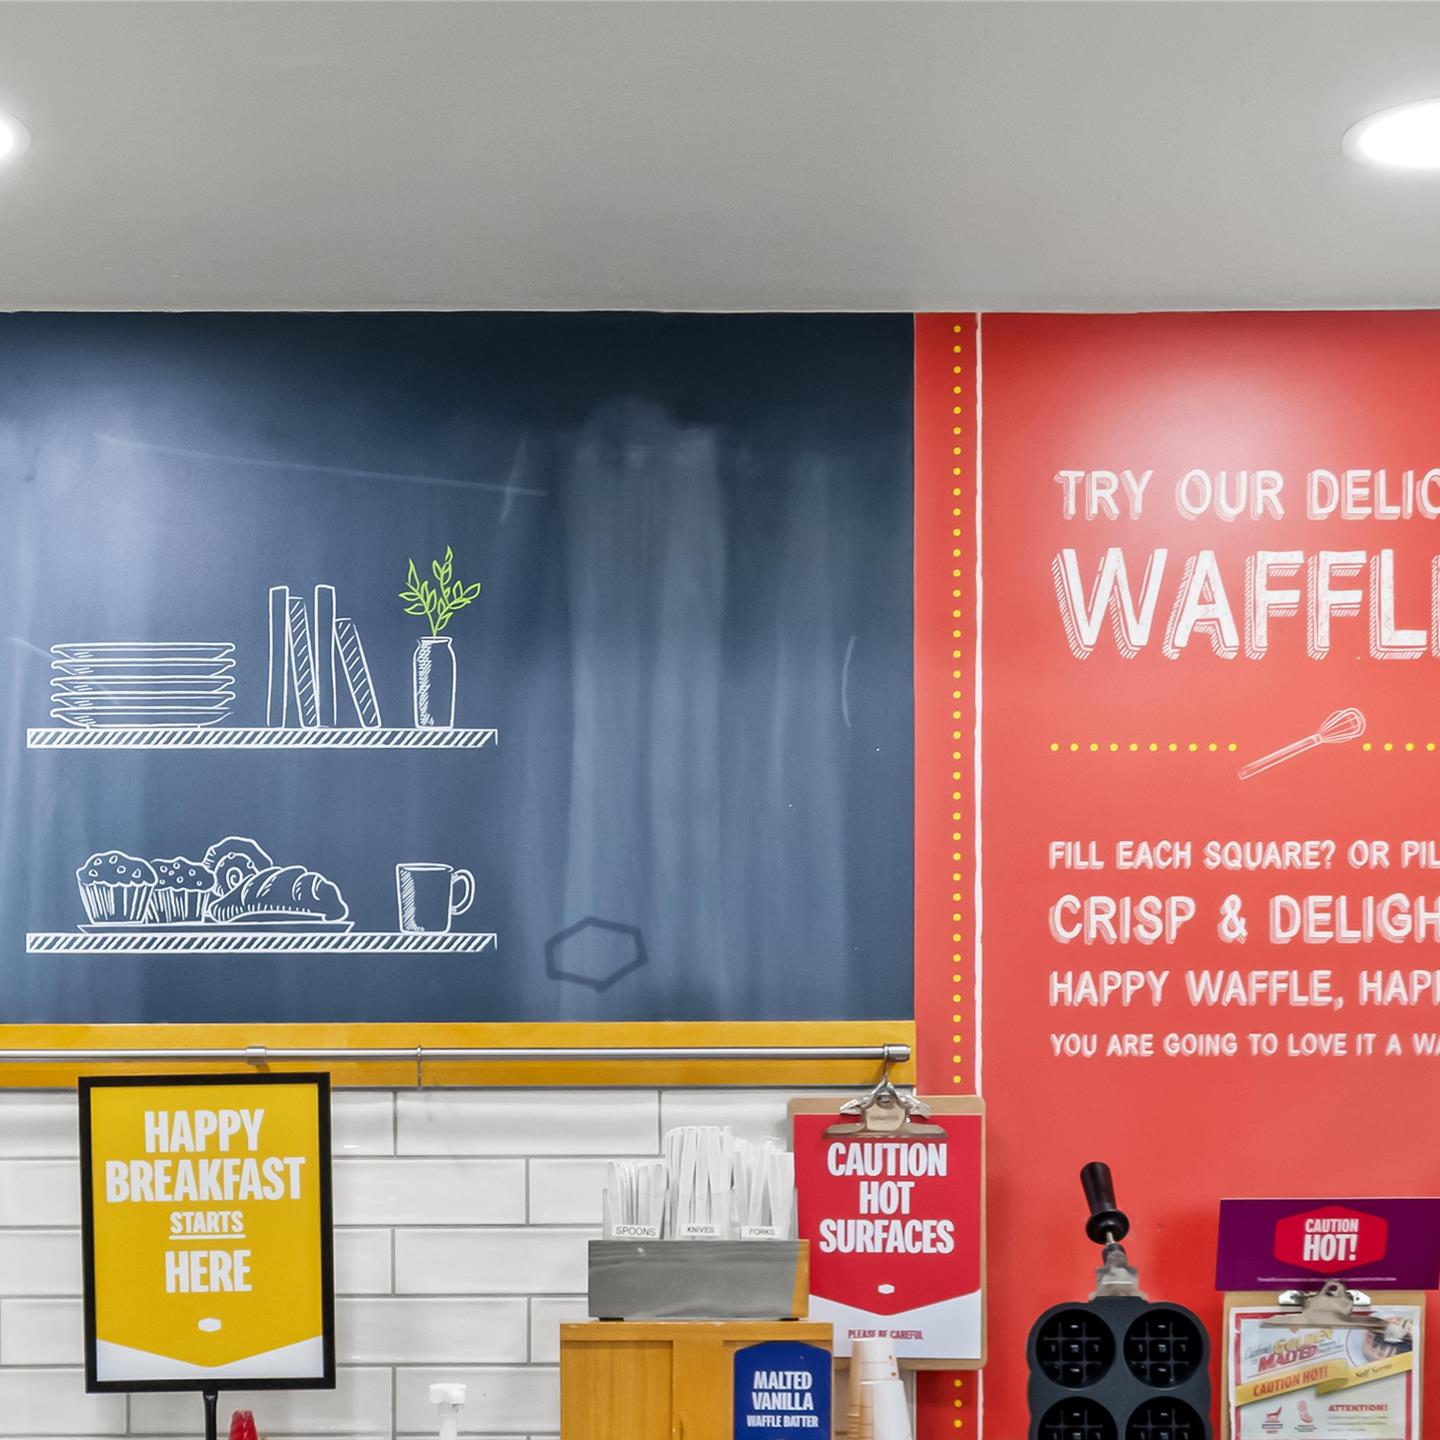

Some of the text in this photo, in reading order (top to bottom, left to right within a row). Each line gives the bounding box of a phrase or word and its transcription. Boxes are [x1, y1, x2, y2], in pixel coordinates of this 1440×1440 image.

[1054, 468, 1154, 520] TRY
[1175, 468, 1285, 521] OUR
[1049, 840, 1105, 870] FILL
[1116, 840, 1192, 870] EACH
[1203, 839, 1336, 870] SQUARE?
[1348, 839, 1390, 869] OR
[1049, 894, 1196, 945] CRISP
[1217, 893, 1248, 944] &
[1049, 969, 1169, 1006] HAPPY
[1185, 969, 1344, 1011] WAFFLE,
[1050, 1033, 1097, 1057] YOU
[1106, 1033, 1154, 1057] ARE
[1163, 1033, 1238, 1057] GOING
[1249, 1033, 1279, 1056] TO
[1287, 1033, 1347, 1057] LOVE
[1356, 1033, 1377, 1056] IT
[1385, 1033, 1402, 1056] A
[144, 1109, 265, 1153] HAPPY
[827, 1142, 948, 1176] CAUTION
[105, 1157, 306, 1203] BREAKFAST
[859, 1181, 915, 1214] HOT
[170, 1210, 244, 1234] STARTS
[616, 1226, 656, 1236] SPOONS
[687, 1226, 715, 1234] KNIVES
[749, 1228, 775, 1236] FORKS
[819, 1219, 955, 1254] SURFACES
[1305, 1218, 1359, 1233] CAUTION
[1303, 1234, 1358, 1261] HOT!
[165, 1250, 252, 1293] HERE
[753, 1371, 813, 1390] MALTED
[1252, 1365, 1329, 1397] CAUTION HOT!
[751, 1392, 815, 1411] VANILLA
[1327, 1403, 1388, 1412] ATTENTION!
[746, 1415, 819, 1428] WAFFLE BATTER
